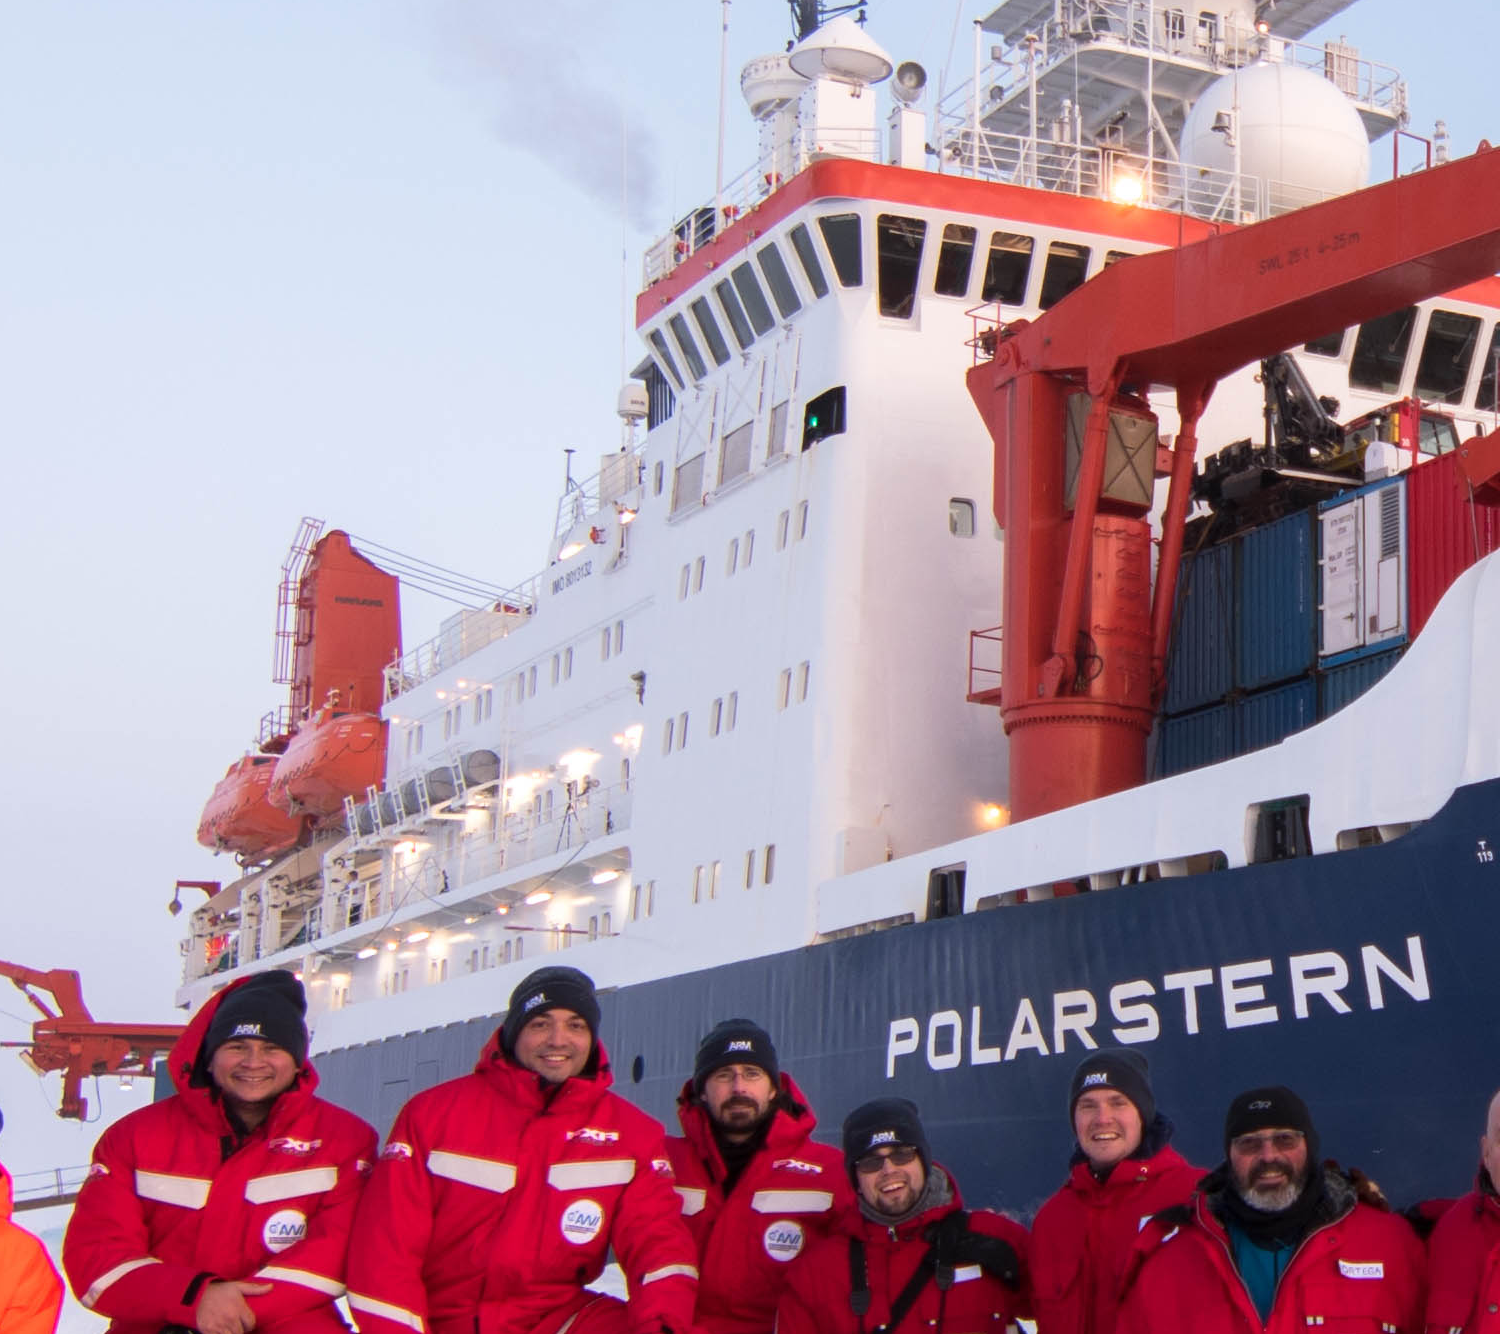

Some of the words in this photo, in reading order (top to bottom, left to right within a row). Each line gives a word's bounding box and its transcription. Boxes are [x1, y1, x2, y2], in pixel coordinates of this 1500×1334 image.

[552, 576, 564, 595] IMO
[1478, 841, 1486, 850] T
[1477, 851, 1493, 863] 119
[886, 935, 1431, 1079] POLARSTERN
[234, 1024, 260, 1035] ARM
[728, 1041, 752, 1051] ARM
[1084, 1073, 1107, 1086] ARM
[871, 1131, 895, 1144] ARM
[575, 1213, 600, 1227] AWI
[279, 1224, 305, 1235] AWI
[776, 1233, 801, 1245] AWI
[1341, 1265, 1381, 1276] ORTEGA
